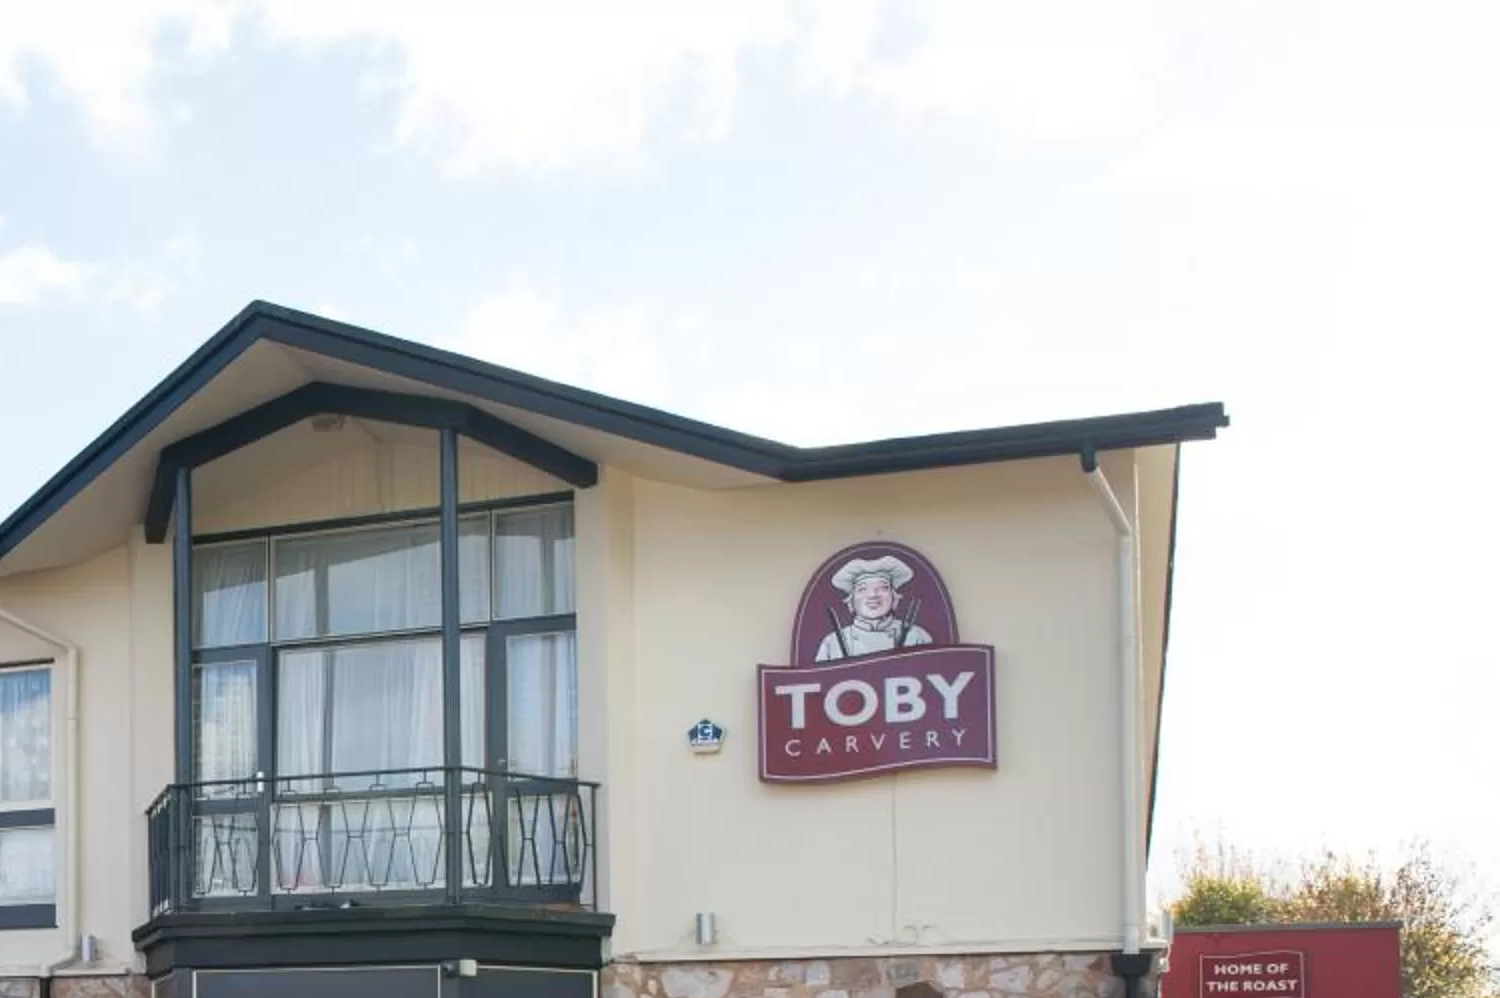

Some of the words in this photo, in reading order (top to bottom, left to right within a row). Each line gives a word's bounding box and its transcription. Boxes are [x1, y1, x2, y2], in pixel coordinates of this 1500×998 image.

[775, 671, 976, 729] TOBY
[785, 728, 968, 757] CARVERY
[1213, 963, 1263, 975] HOME
[1266, 963, 1289, 975] OF
[1204, 981, 1239, 992] THE
[1243, 979, 1299, 992] ROAST
